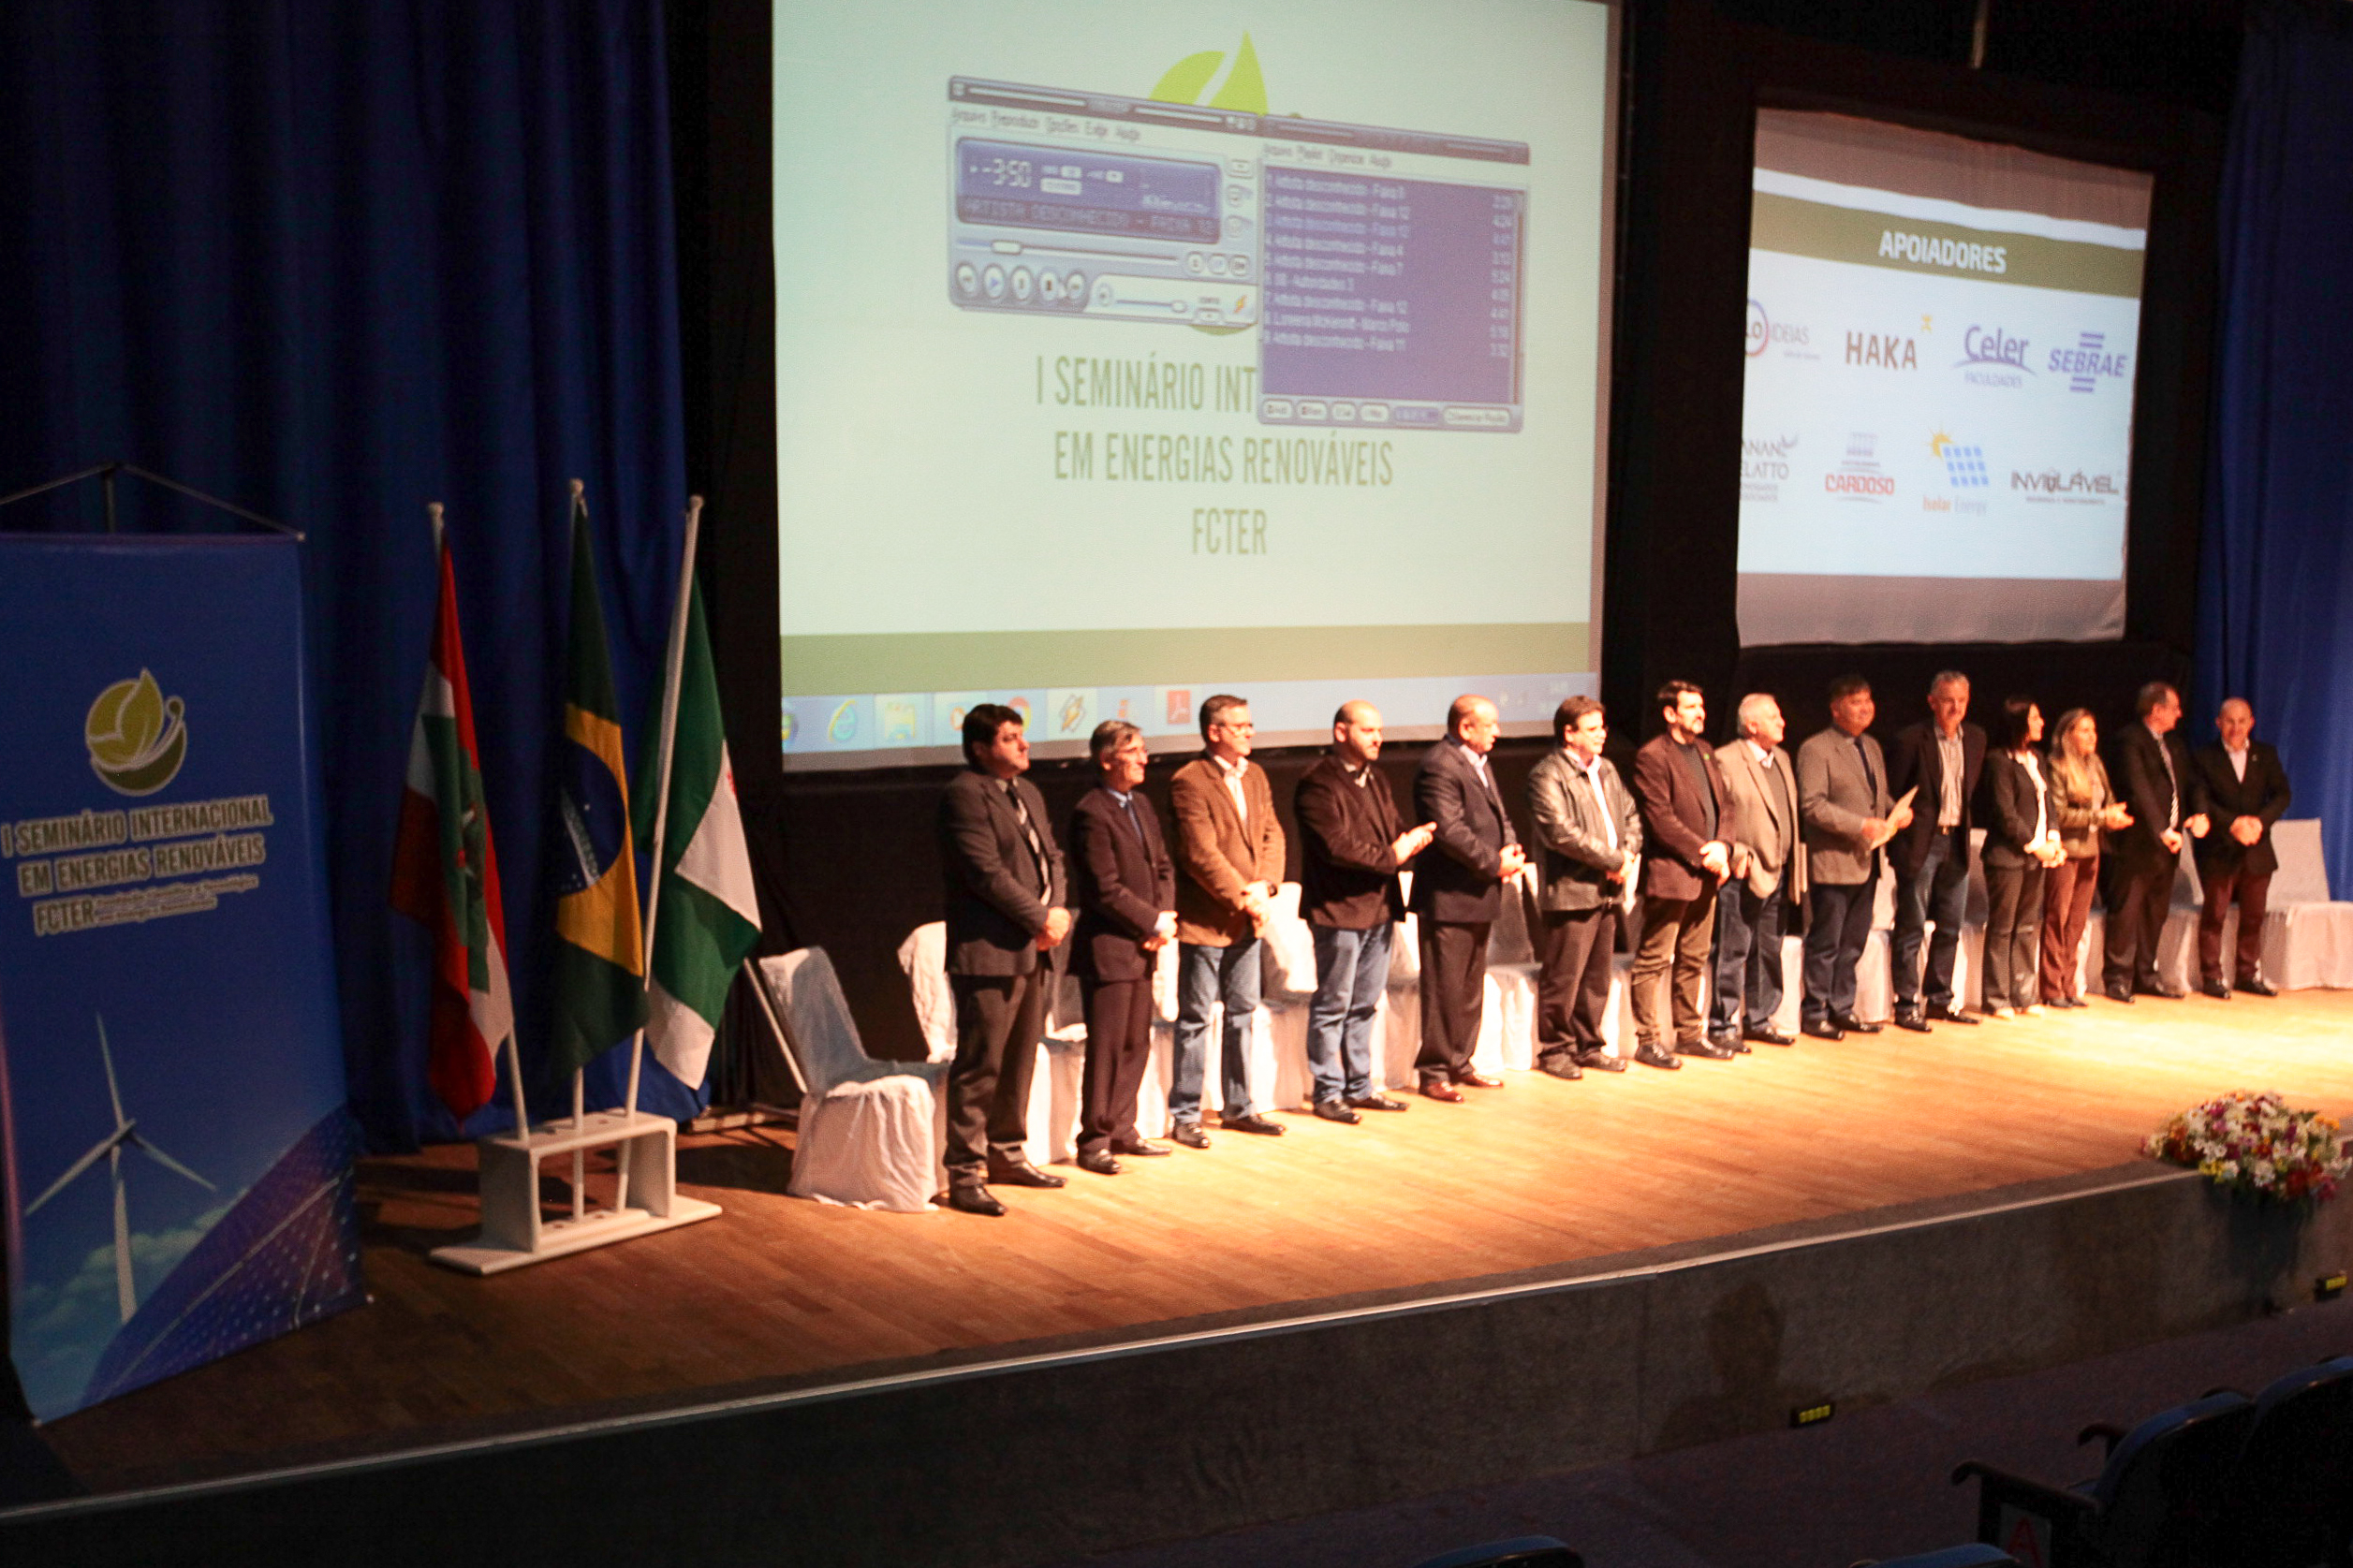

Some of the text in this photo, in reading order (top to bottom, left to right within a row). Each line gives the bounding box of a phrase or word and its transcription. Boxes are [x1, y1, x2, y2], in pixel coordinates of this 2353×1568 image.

[1878, 230, 2007, 273] APOIADORES
[1846, 330, 1917, 370] HAKA
[1964, 325, 2029, 366] Celer
[2048, 348, 2127, 377] SEBRAE
[1037, 355, 1043, 404] I
[1054, 351, 1204, 410] SEMINÁRIO
[1054, 430, 1393, 486] EM ENERGIAS RENOVÁVEIS
[1825, 474, 1895, 495] CARDOSO
[1192, 508, 1268, 555] FCTER
[2, 796, 273, 857] I SEMINÁRIO INTERNACIONAL
[19, 861, 51, 896] EM
[55, 848, 152, 891] ENERGIAS
[154, 833, 265, 876] RENOVÁVEIS
[34, 896, 95, 934] FCTER
